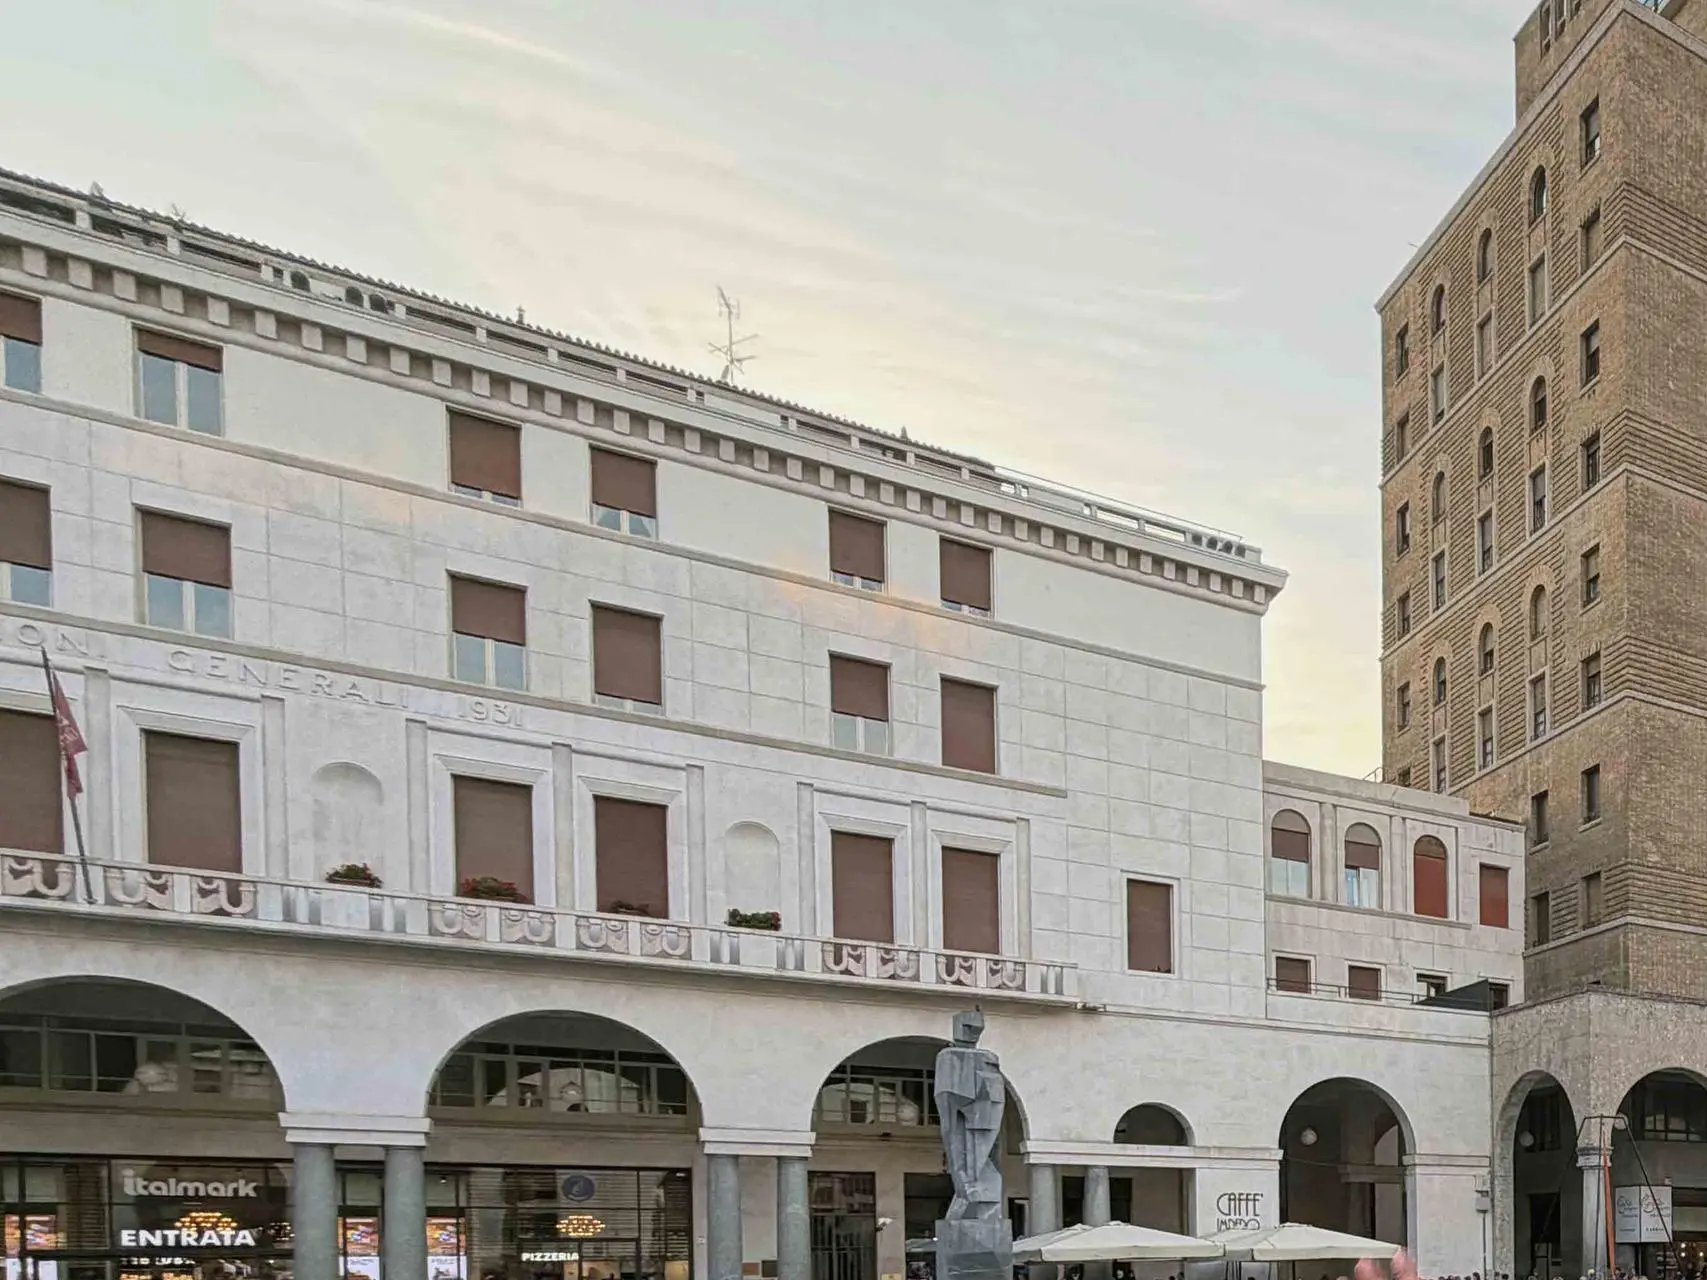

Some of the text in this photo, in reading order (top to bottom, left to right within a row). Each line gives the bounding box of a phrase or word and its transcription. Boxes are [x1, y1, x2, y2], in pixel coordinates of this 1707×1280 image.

[121, 1168, 258, 1198] italmark
[120, 1230, 257, 1247] ENTRATA
[521, 1252, 580, 1262] PIZZERIA
